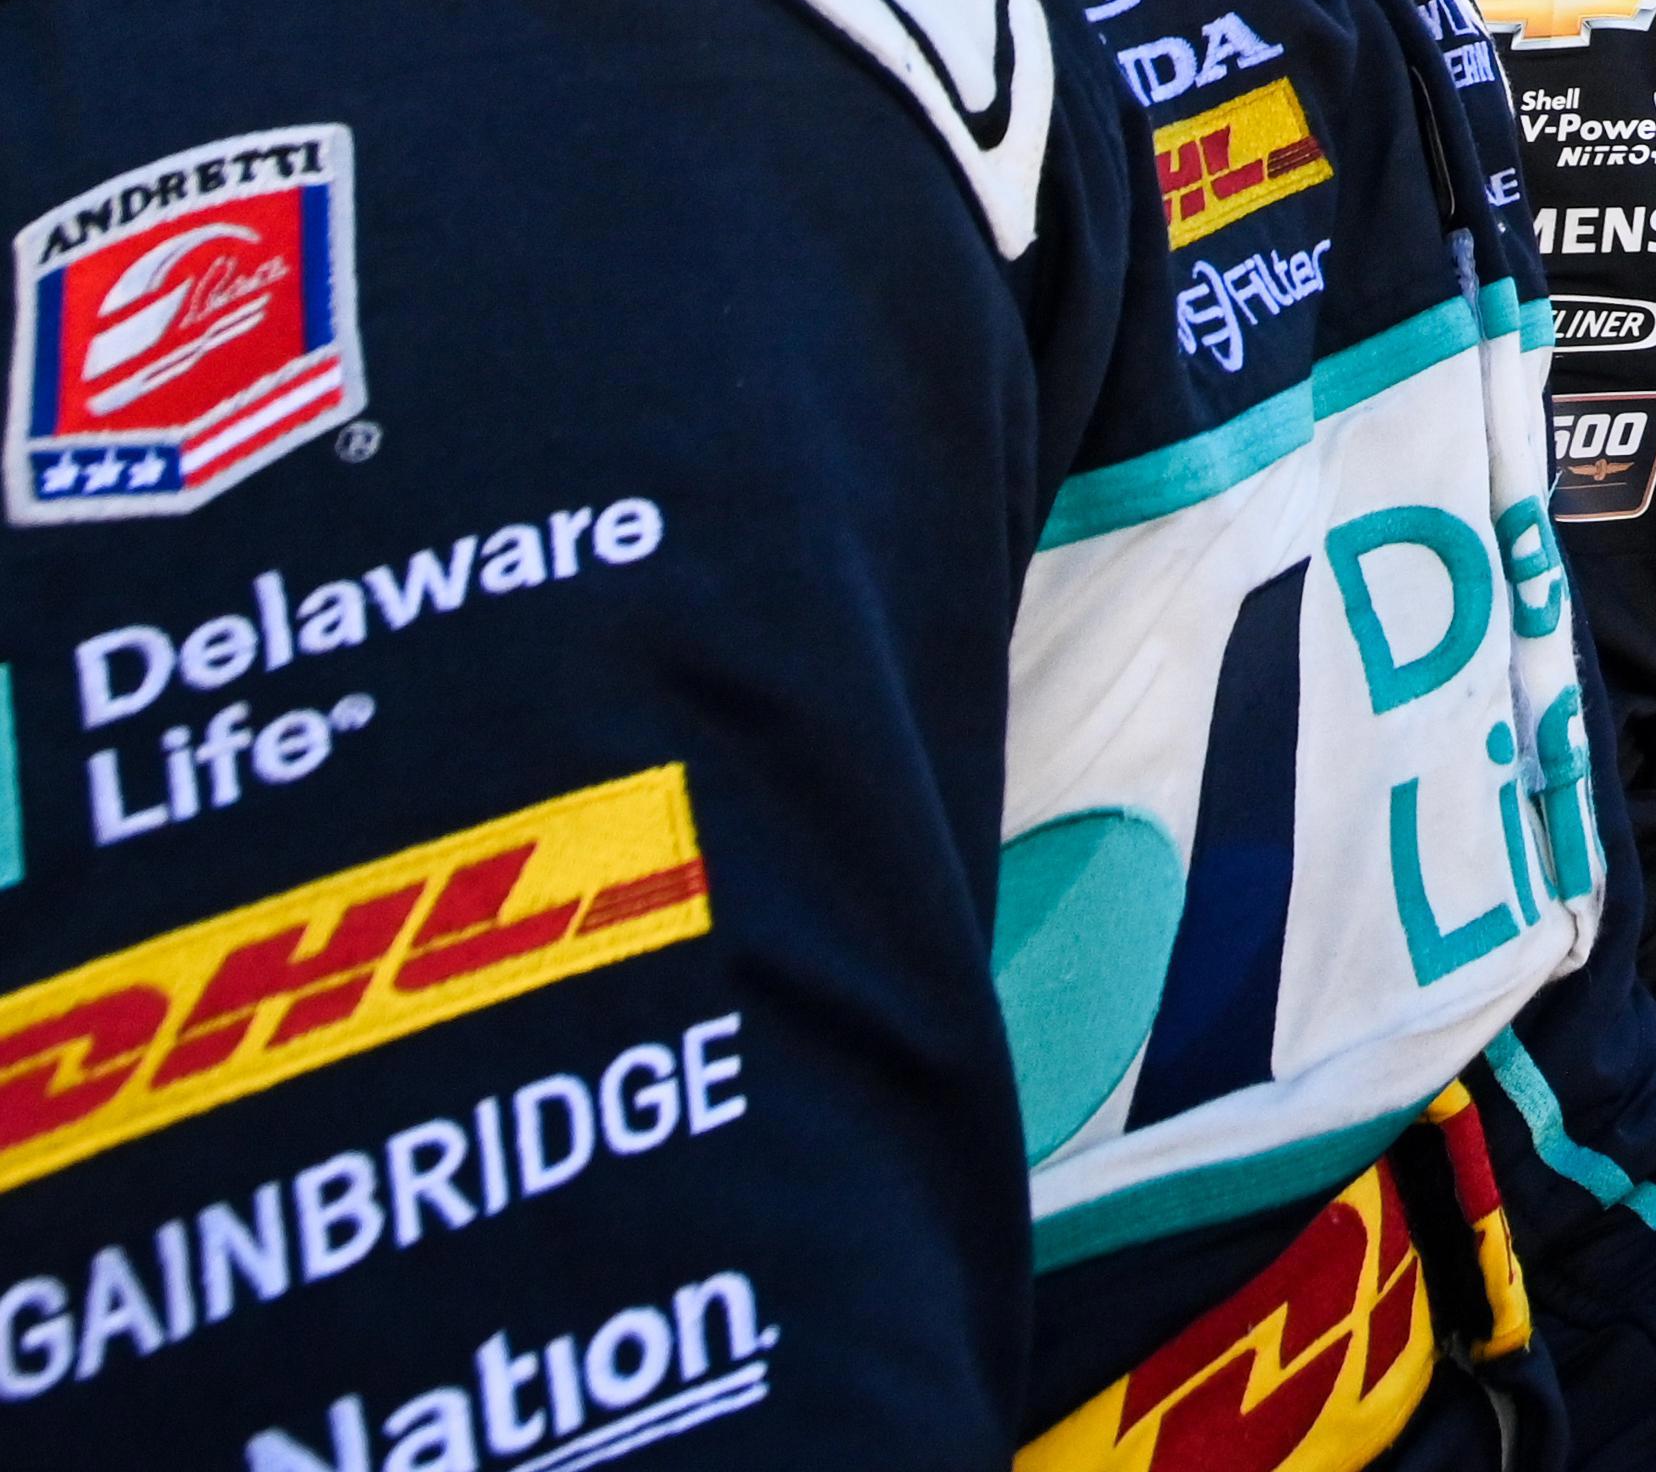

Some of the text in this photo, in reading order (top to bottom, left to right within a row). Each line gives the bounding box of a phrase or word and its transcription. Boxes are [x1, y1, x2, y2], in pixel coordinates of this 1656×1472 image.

[38, 141, 329, 266] ANDRETTI
[1521, 88, 1580, 112] Shell
[75, 496, 664, 730] Delaware
[0, 840, 582, 1152] DHL
[0, 1013, 748, 1403] GAINBRIDGE
